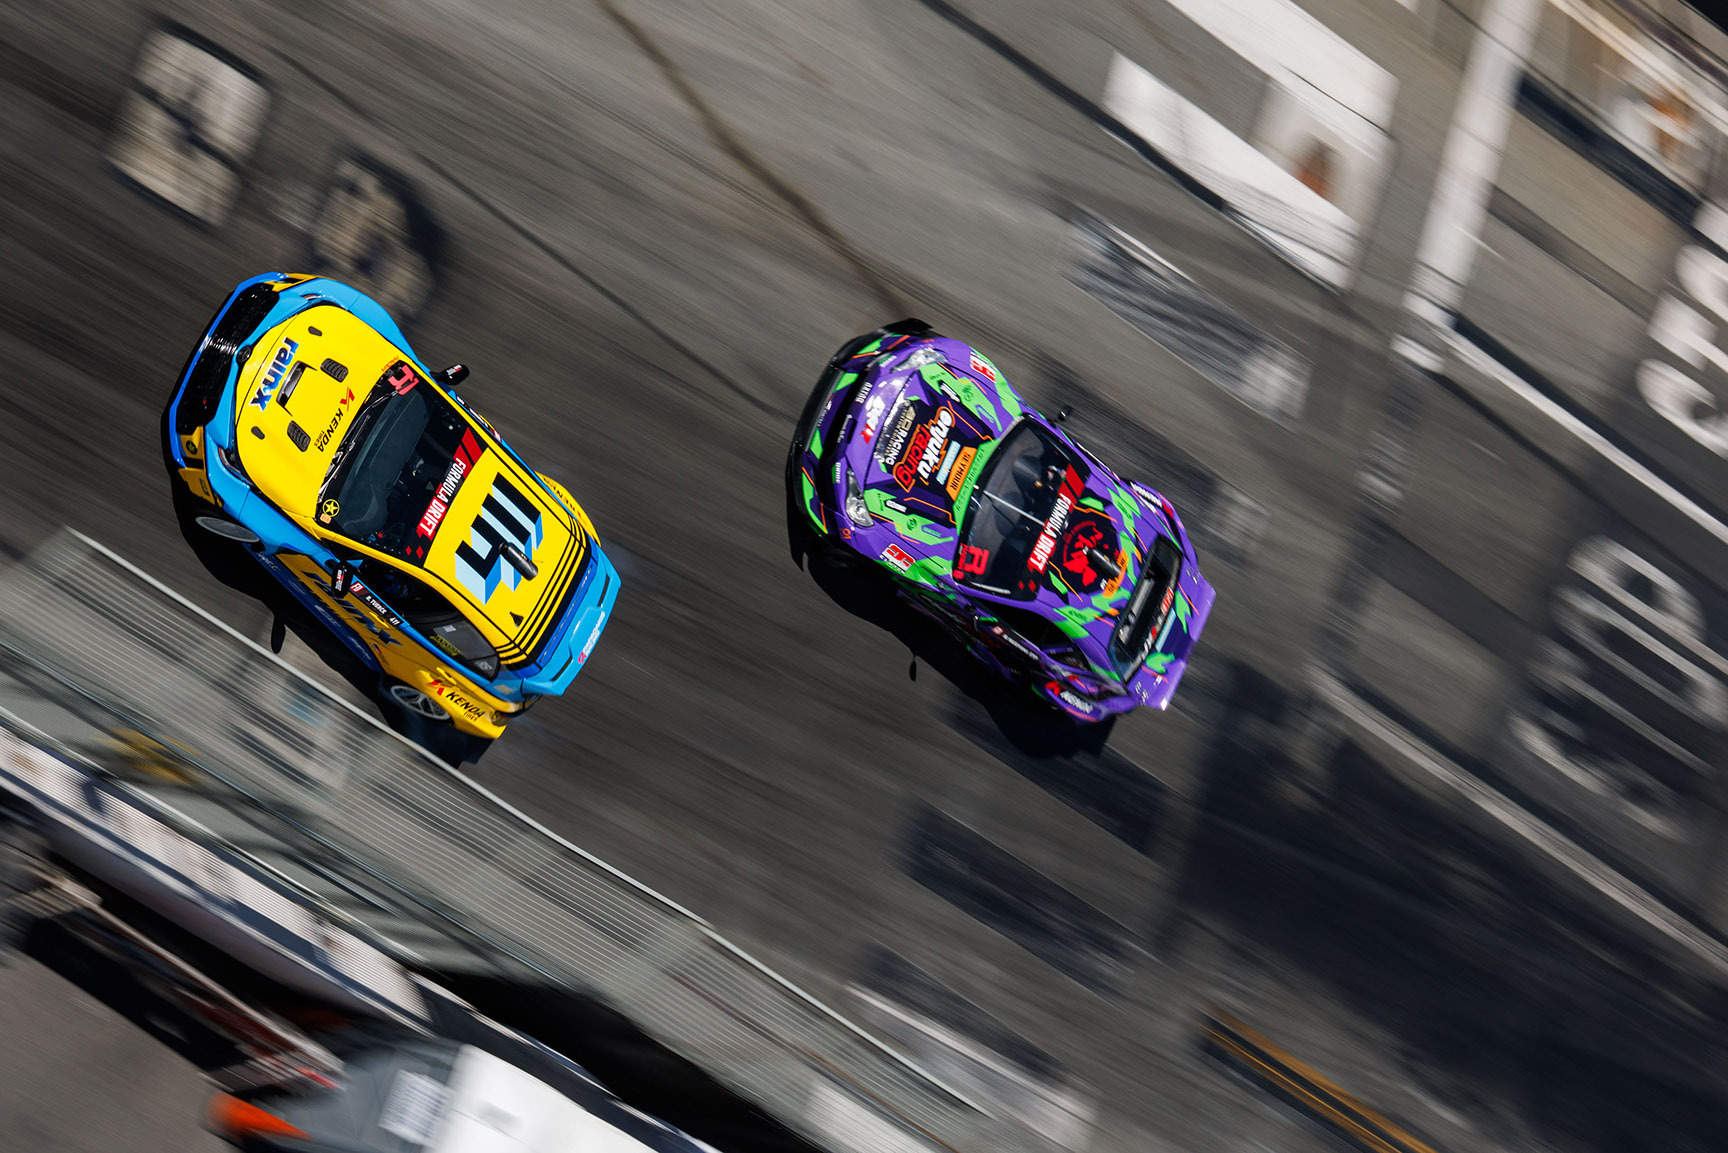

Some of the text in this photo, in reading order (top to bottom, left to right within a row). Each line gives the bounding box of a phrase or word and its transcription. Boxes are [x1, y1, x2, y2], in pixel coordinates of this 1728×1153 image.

[313, 430, 326, 448] TIRES
[317, 408, 344, 453] KENDA
[885, 430, 908, 466] RACING
[896, 426, 931, 487] racing
[949, 453, 971, 491] SEYMOUR
[419, 457, 467, 537] FORMULA DRIFT
[1029, 493, 1072, 572] FORMULA DRIFT
[370, 598, 388, 615] TUERCK
[389, 616, 401, 626] 411
[446, 691, 486, 719] KENDA
